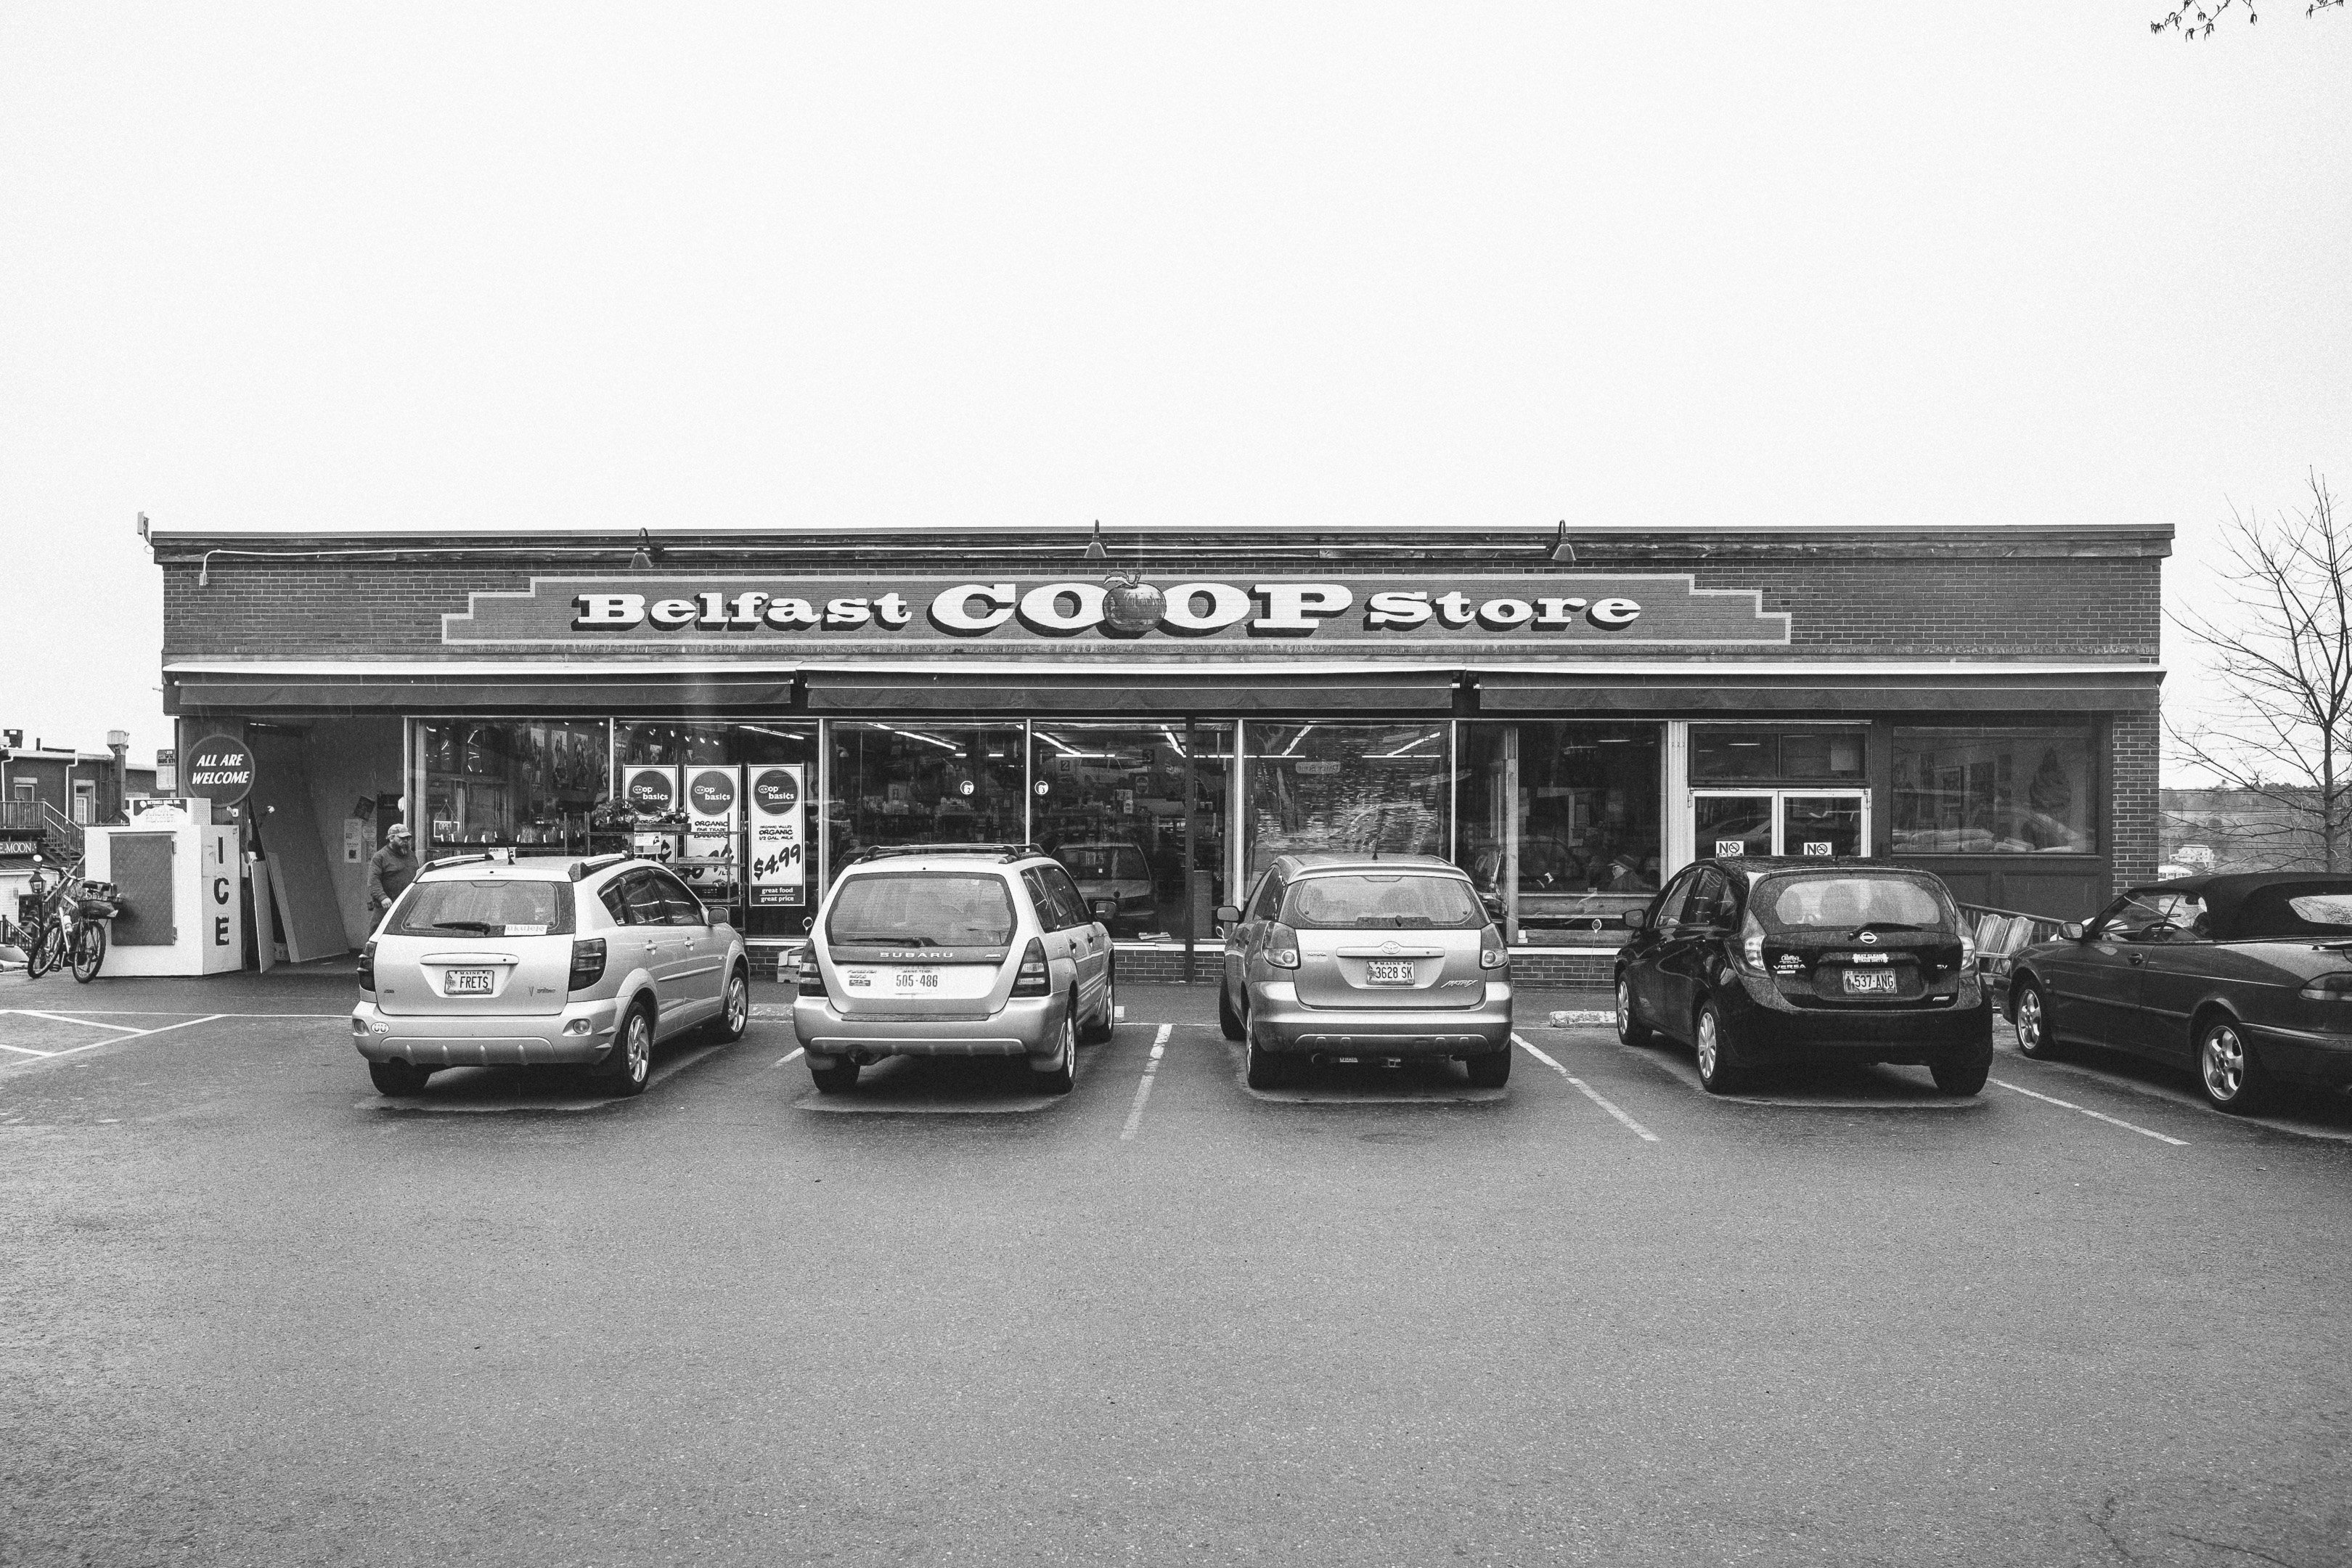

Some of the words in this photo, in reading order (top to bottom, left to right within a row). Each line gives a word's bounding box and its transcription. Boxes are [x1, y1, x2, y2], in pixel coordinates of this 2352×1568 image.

[571, 592, 912, 632] Belfast
[1363, 591, 1641, 632] Store
[196, 754, 217, 767] ALL
[219, 754, 245, 767] ARE
[192, 771, 250, 785] WELCOME
[6, 842, 32, 854] MOON
[754, 844, 801, 881] $4.99
[213, 836, 230, 947] ICE
[778, 894, 794, 903] price
[1376, 966, 1398, 979] 3628
[1401, 966, 1413, 979] SK
[460, 976, 489, 989] FRETS
